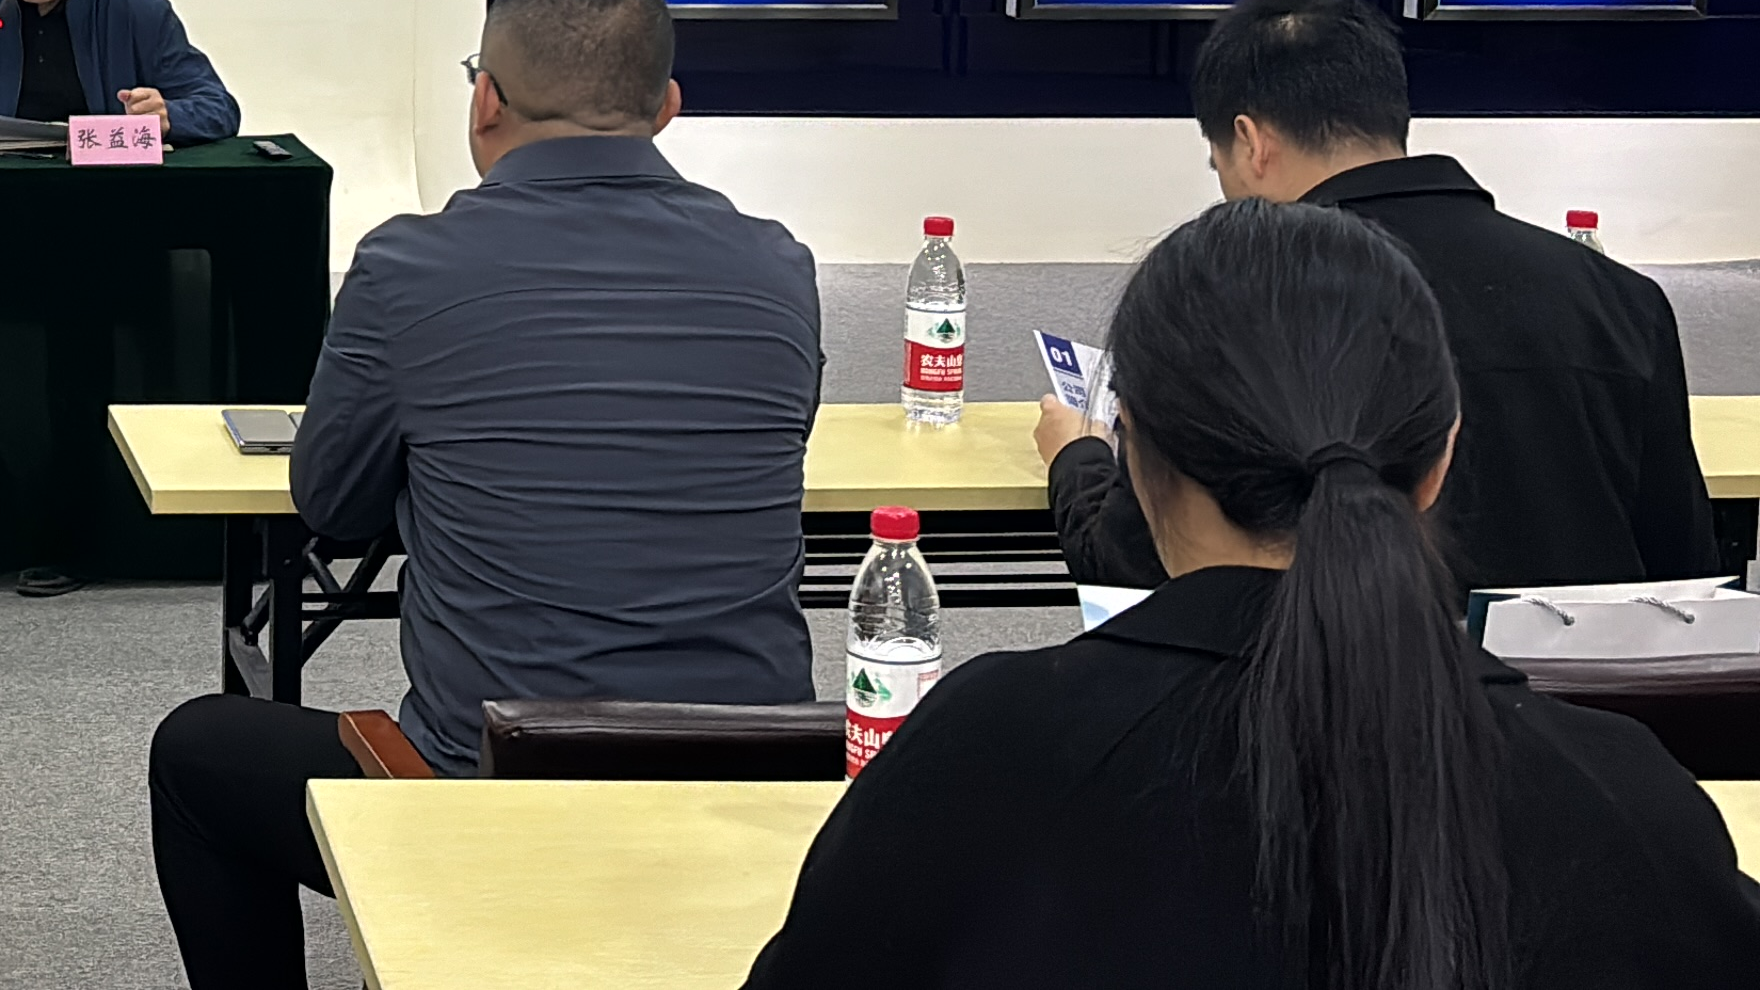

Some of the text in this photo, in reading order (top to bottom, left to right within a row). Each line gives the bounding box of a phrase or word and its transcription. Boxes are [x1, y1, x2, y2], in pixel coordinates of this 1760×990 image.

[77, 126, 157, 150] 张益海
[1050, 346, 1073, 367] 01
